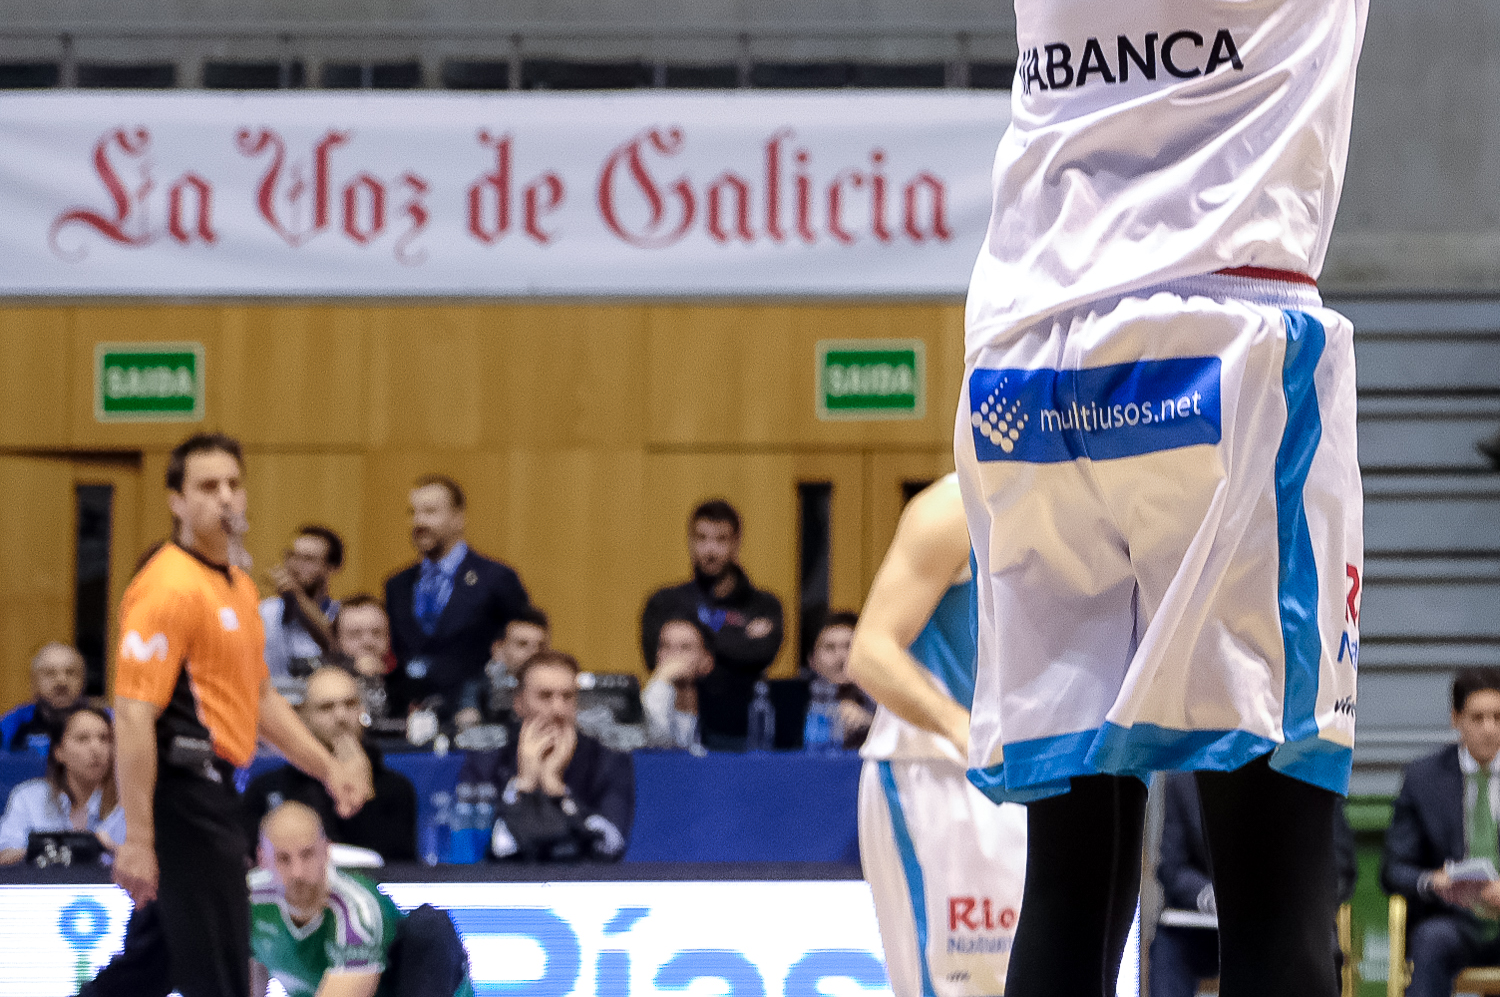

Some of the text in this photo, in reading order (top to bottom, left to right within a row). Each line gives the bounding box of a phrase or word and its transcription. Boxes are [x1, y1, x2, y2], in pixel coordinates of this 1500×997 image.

[48, 124, 953, 267] La Voz de Galicia
[106, 364, 193, 399] SAIDA
[827, 362, 914, 397] SAIDA
[1039, 389, 1202, 433] multiusos.net
